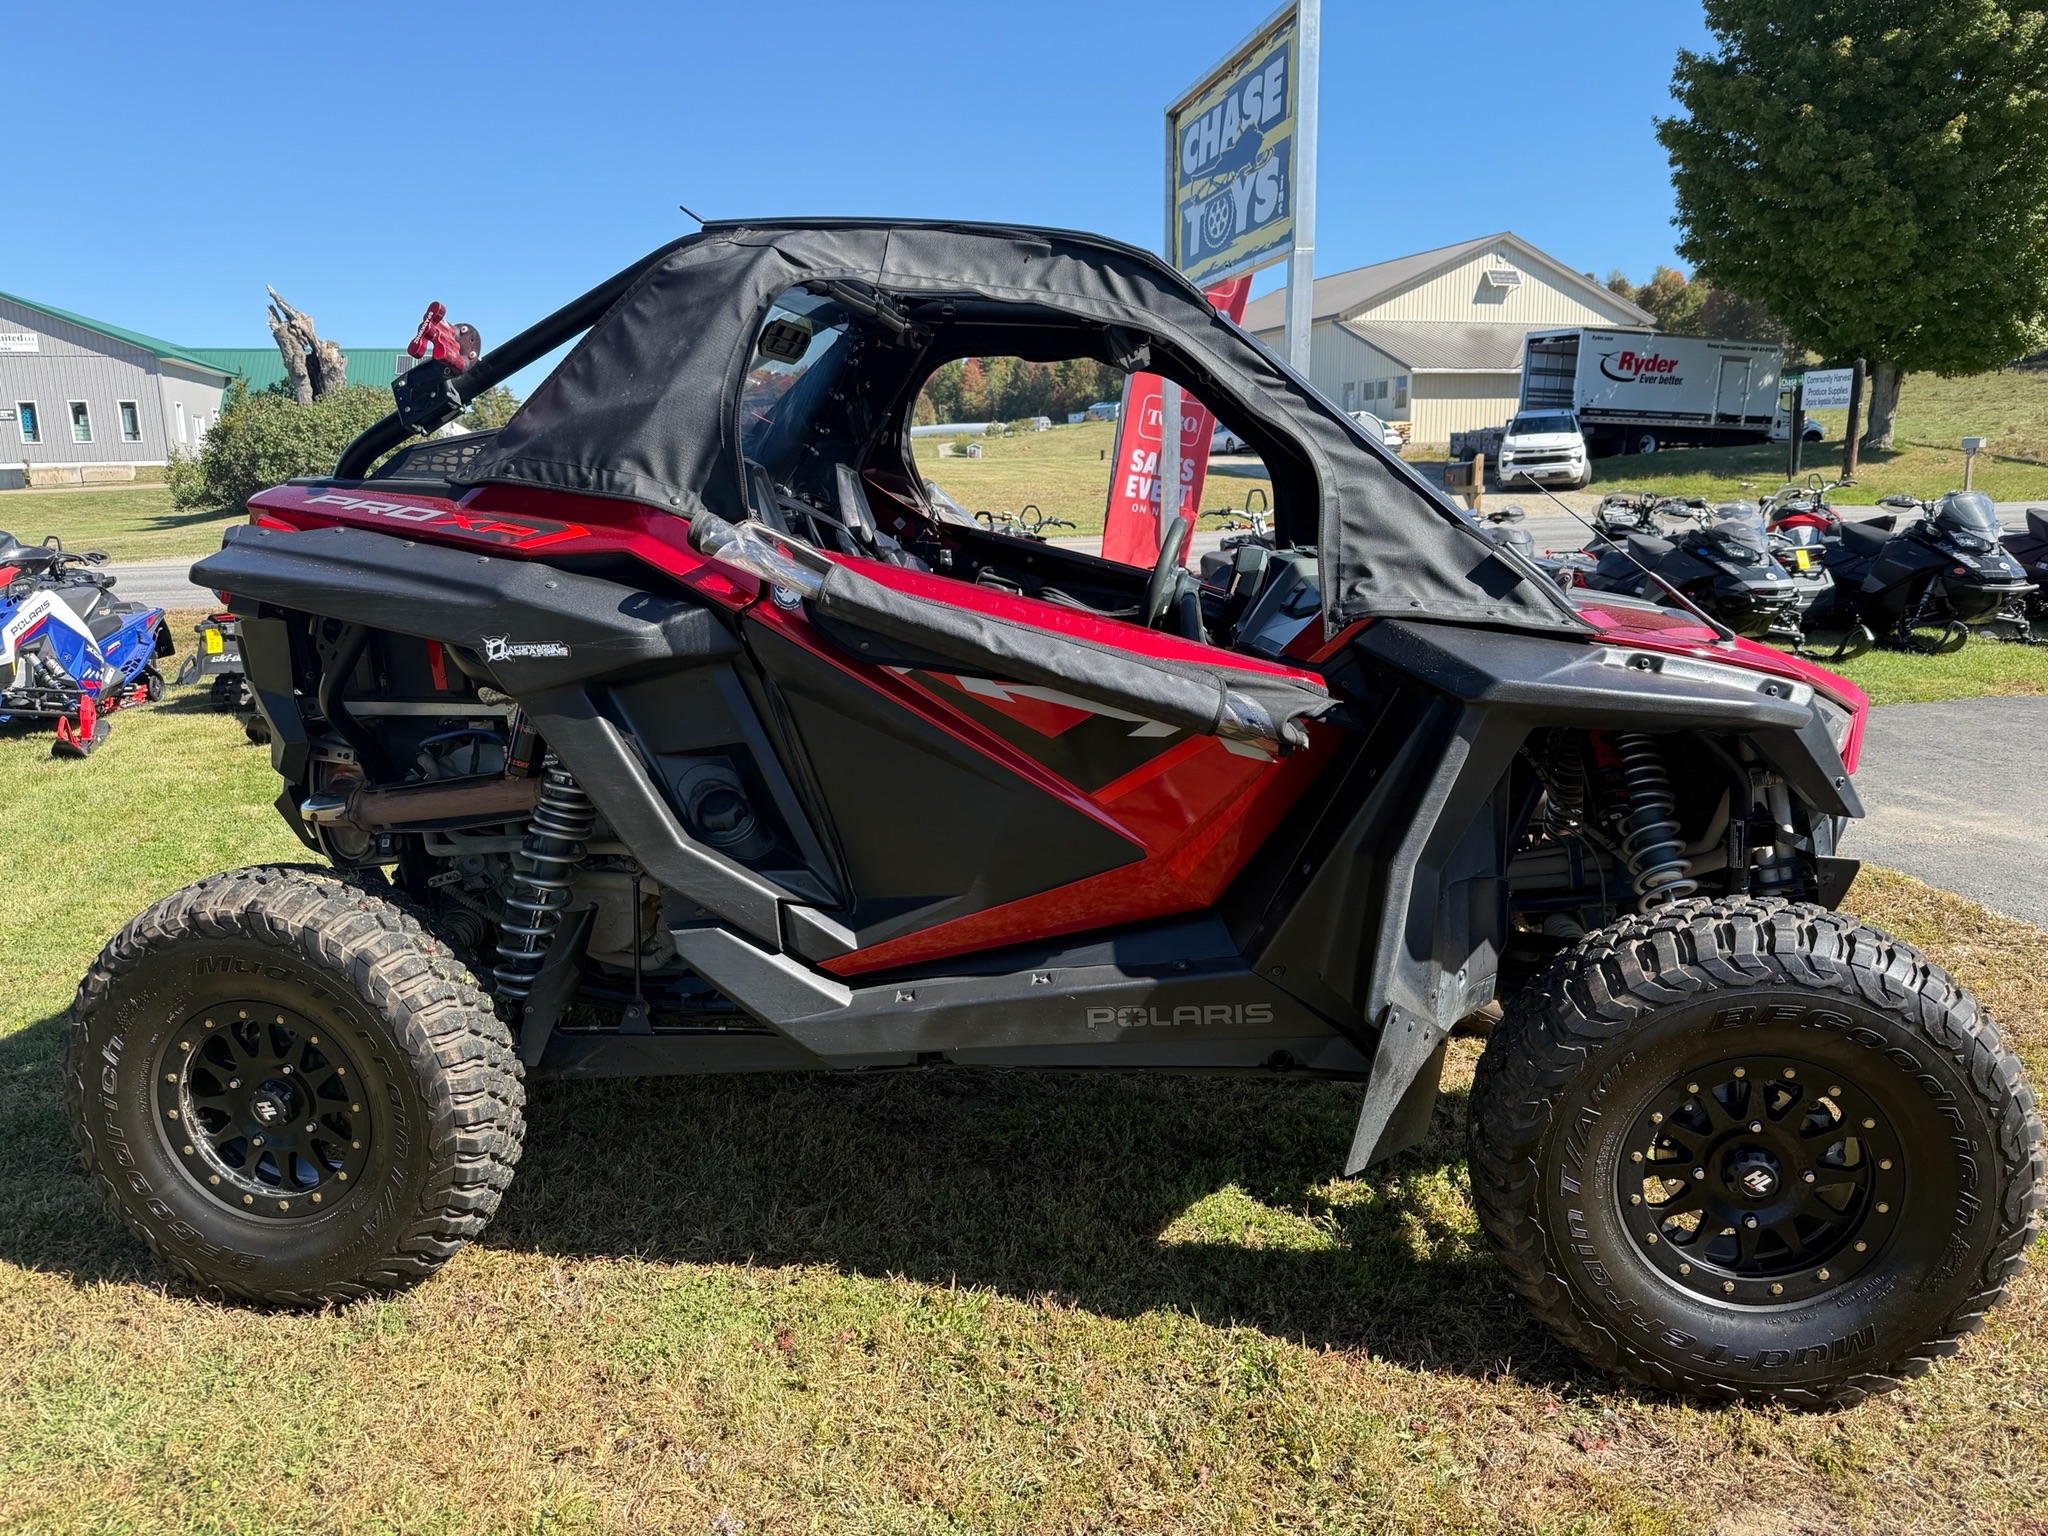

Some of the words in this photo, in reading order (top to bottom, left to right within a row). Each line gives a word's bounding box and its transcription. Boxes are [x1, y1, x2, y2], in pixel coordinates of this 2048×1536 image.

[1182, 56, 1285, 175] CHASE
[1618, 351, 1679, 376] Ryder
[1639, 373, 1658, 385] Ever
[1806, 374, 1834, 384] Community
[1834, 373, 1852, 383] Harvest
[1808, 388, 1827, 396] Produce
[1828, 386, 1849, 396] Supplies
[1125, 474, 1192, 507] EVET
[302, 494, 448, 522] PRO
[430, 513, 541, 537] XP
[1131, 503, 1147, 515] ON
[10, 599, 51, 636] POLARIS
[507, 647, 569, 657] ASSASSINS
[1086, 1003, 1275, 1029] POLARIS
[1711, 1004, 1982, 1227] BFGoodrich
[98, 1034, 266, 1274] BFGoodrich
[1566, 1208, 1877, 1374] Mud-Terrain
